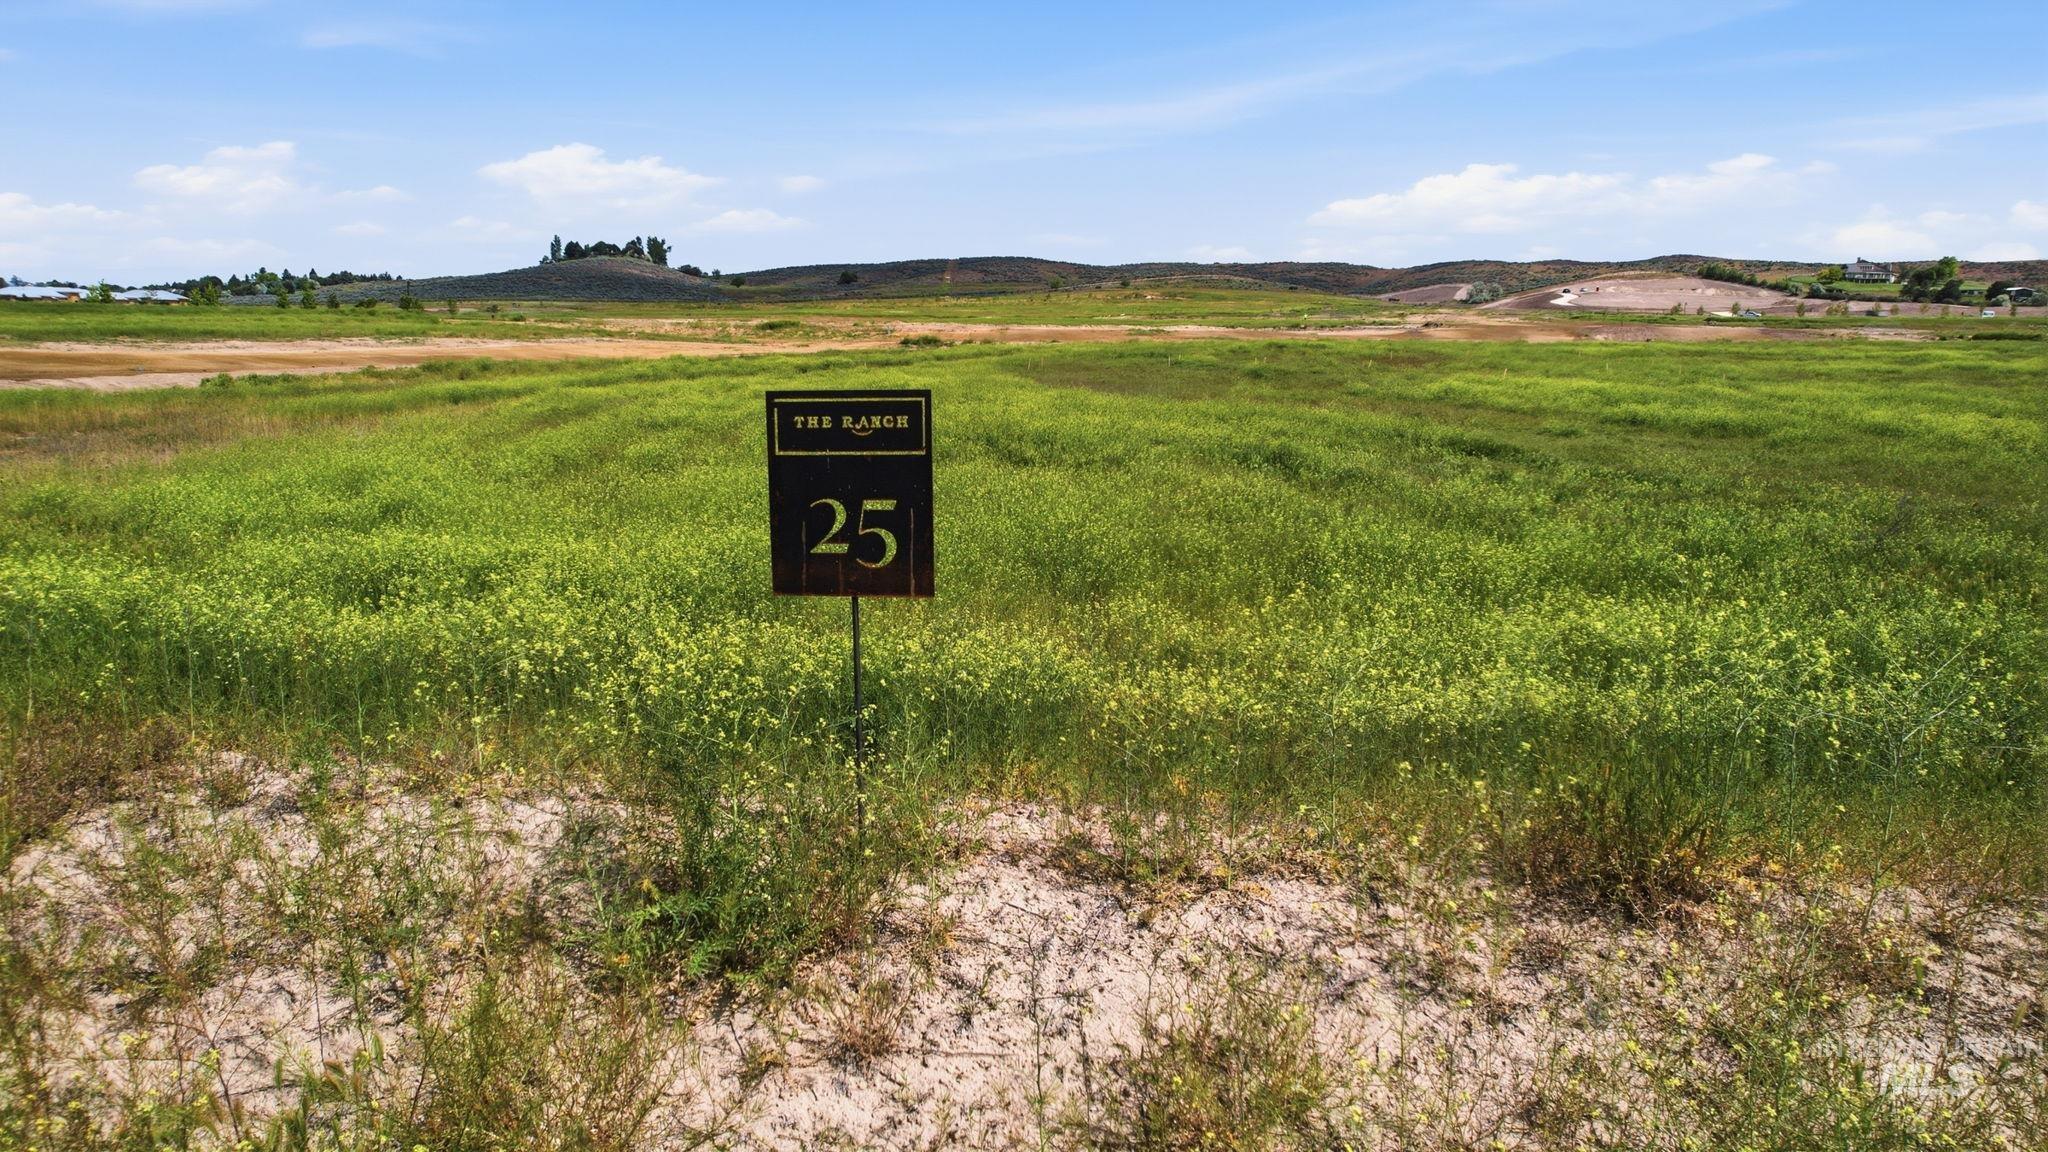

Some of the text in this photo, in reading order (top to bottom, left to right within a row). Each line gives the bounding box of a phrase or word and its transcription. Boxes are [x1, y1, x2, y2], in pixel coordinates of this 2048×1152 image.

[794, 416, 909, 436] THE RANCH
[810, 498, 897, 569] 25
